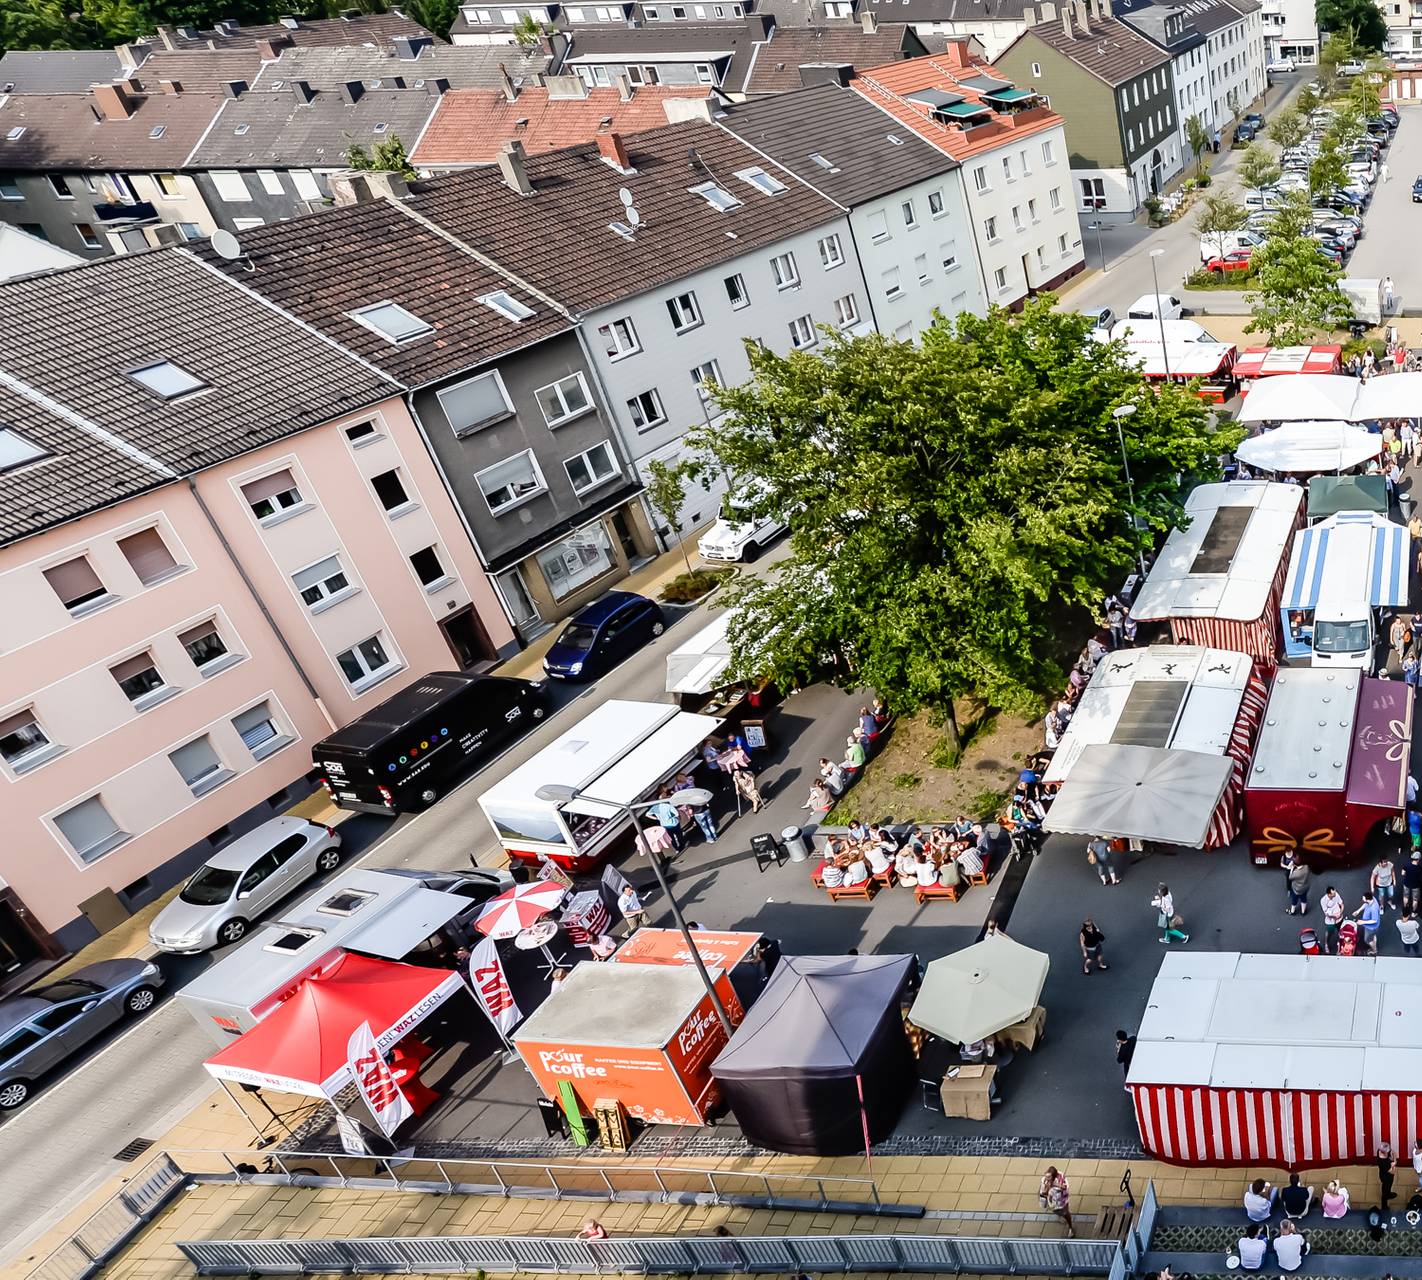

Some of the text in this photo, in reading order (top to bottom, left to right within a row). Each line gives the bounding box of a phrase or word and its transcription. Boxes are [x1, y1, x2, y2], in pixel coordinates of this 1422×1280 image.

[474, 959, 514, 1018] WAZ
[393, 1014, 417, 1034] WAZ
[678, 1009, 701, 1057] pour
[685, 1010, 717, 1052] coffee
[354, 1047, 400, 1113] WAZ
[539, 1048, 583, 1071] pour
[550, 1063, 607, 1078] coffee
